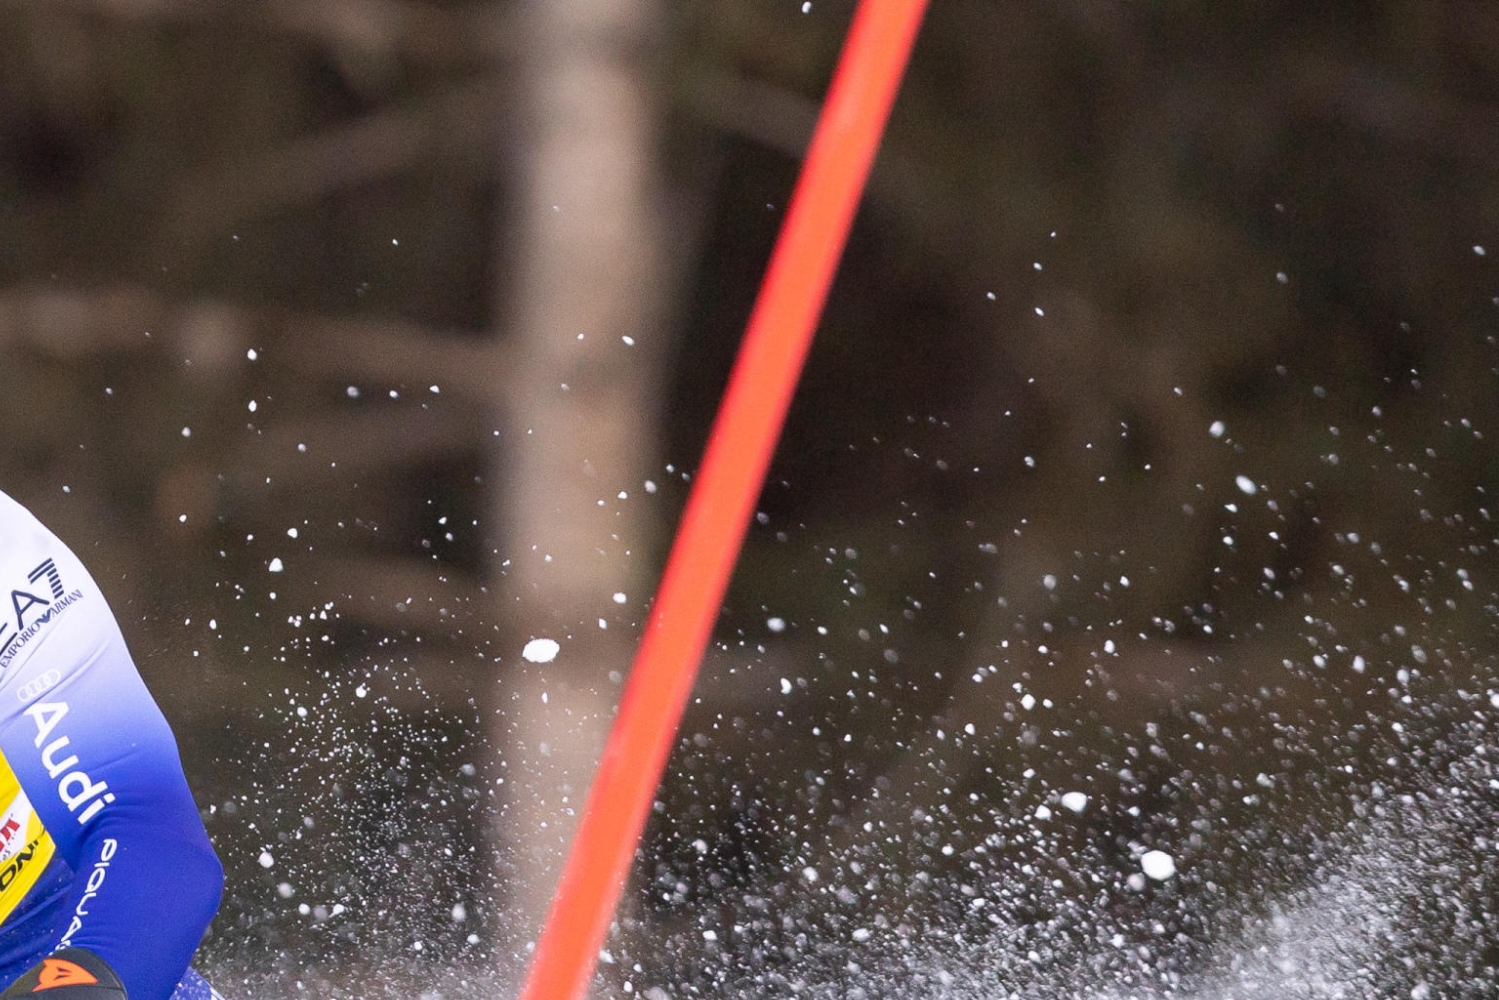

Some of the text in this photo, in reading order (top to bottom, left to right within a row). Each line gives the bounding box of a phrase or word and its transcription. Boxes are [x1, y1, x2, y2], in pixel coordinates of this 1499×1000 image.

[0, 589, 84, 668] EMPORIO ARMANI
[23, 701, 116, 825] Audi
